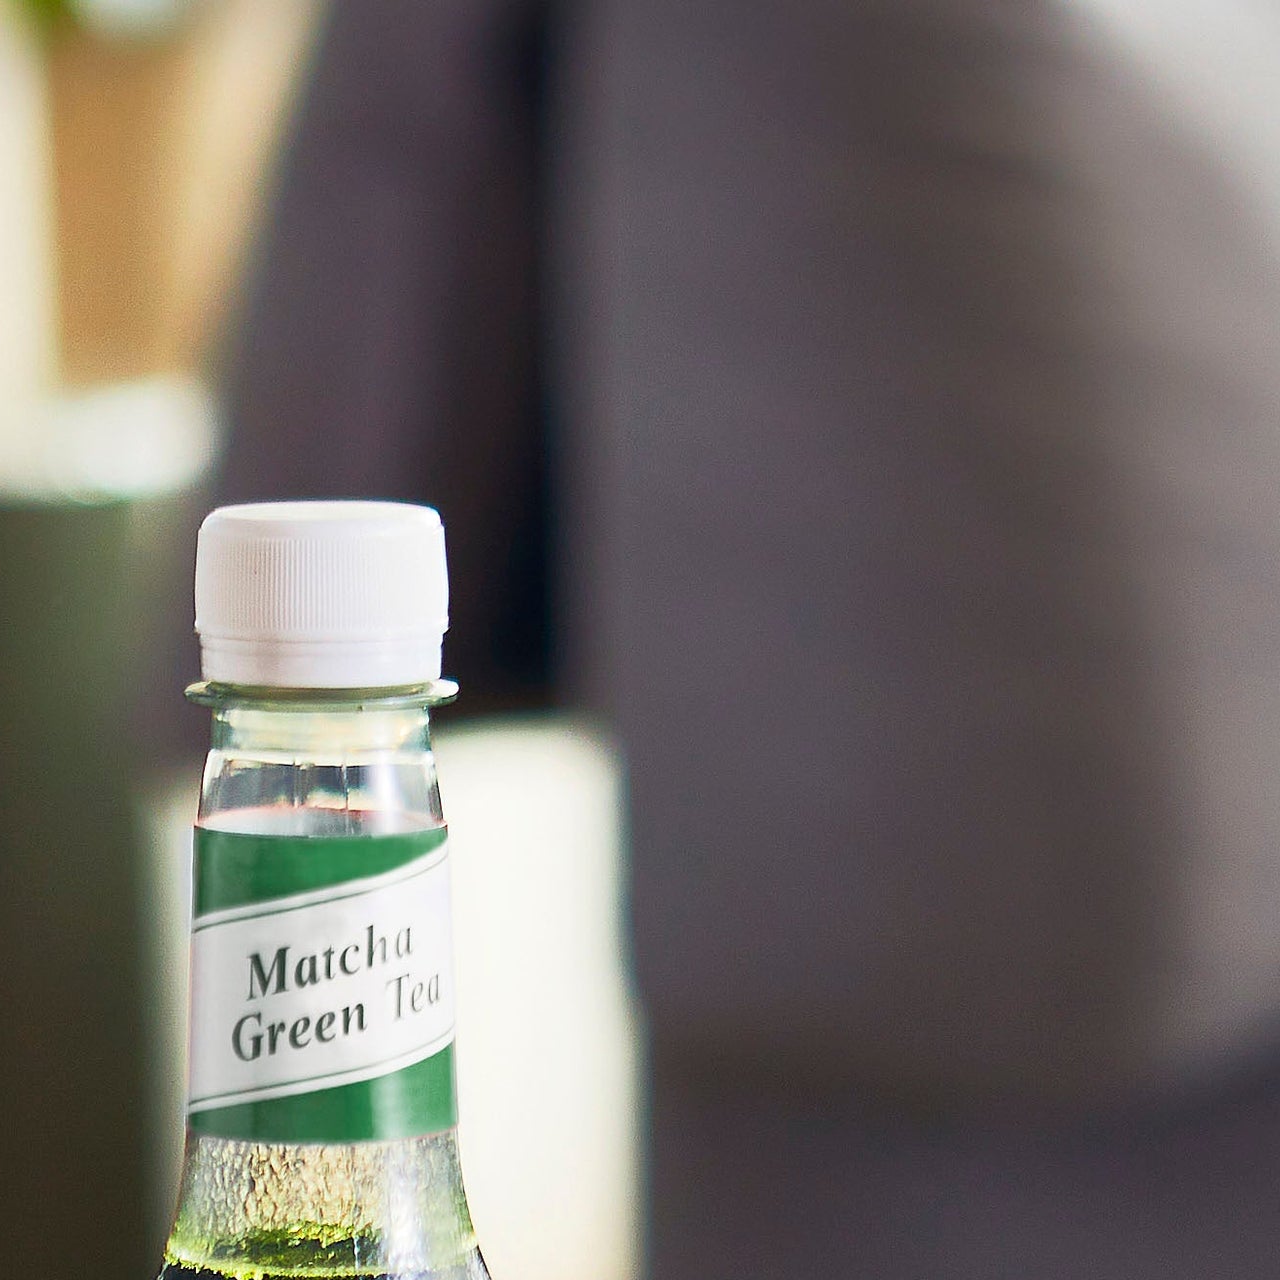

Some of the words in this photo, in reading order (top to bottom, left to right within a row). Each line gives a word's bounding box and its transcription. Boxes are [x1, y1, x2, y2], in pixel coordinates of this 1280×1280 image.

[246, 923, 414, 1002] Matcha
[231, 1002, 368, 1063] Green
[386, 972, 441, 1022] Tea
